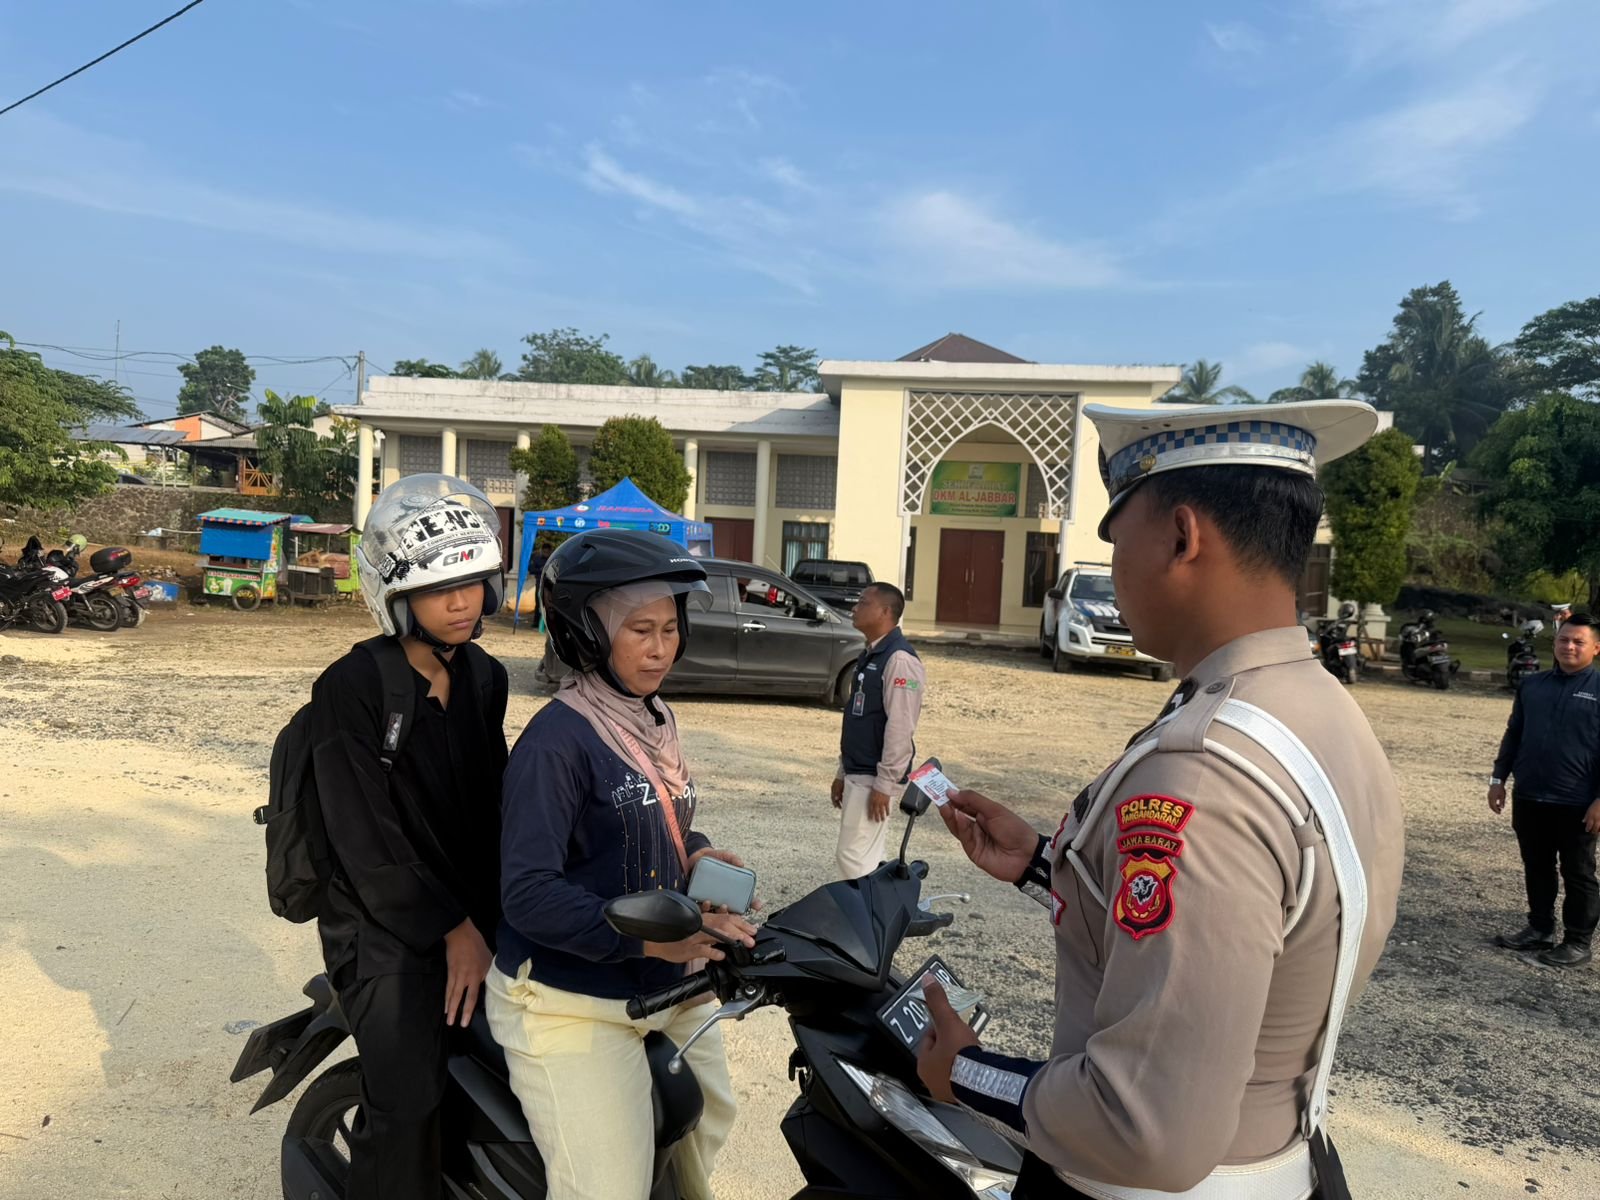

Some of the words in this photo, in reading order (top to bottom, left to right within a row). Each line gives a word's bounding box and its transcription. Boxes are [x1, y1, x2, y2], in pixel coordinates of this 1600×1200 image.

[958, 490, 1016, 504] AL-JABBAR
[442, 548, 475, 567] GM
[1121, 799, 1185, 818] POLRES
[1122, 836, 1143, 848] JAWA
[1145, 836, 1177, 850] BARAT
[889, 1017, 914, 1045] Z
